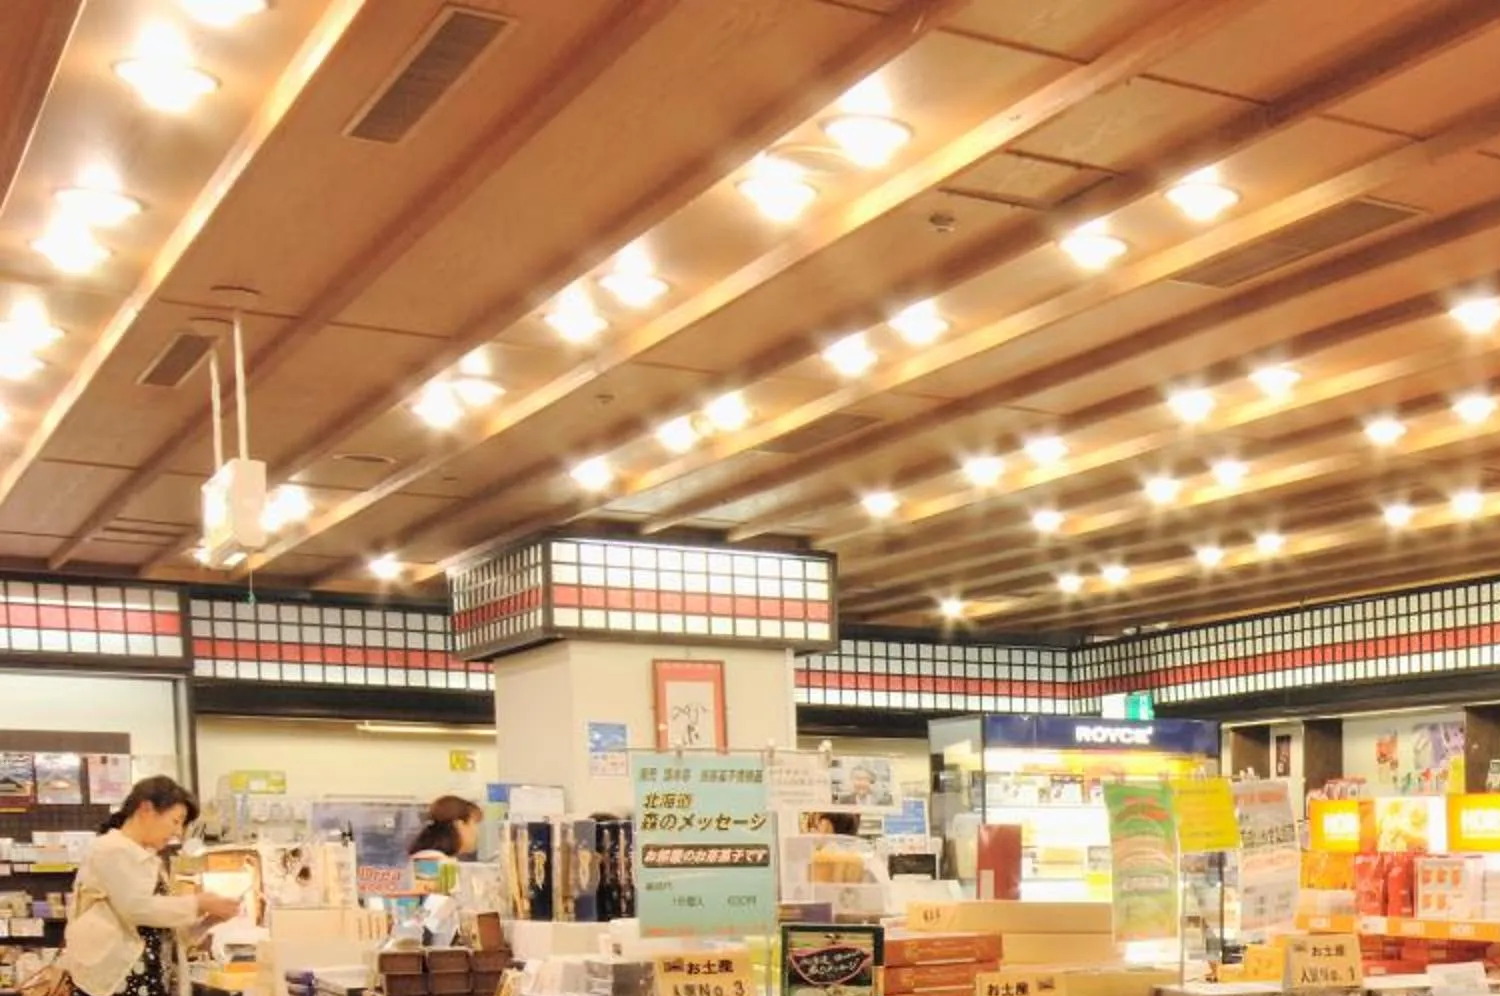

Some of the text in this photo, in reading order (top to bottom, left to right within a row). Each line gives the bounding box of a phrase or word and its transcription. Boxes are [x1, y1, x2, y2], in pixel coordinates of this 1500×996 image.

[644, 792, 694, 809] 北海道
[641, 813, 766, 832] 森のメッセージ
[687, 959, 734, 974] お土産
[987, 982, 1029, 996] お土産
